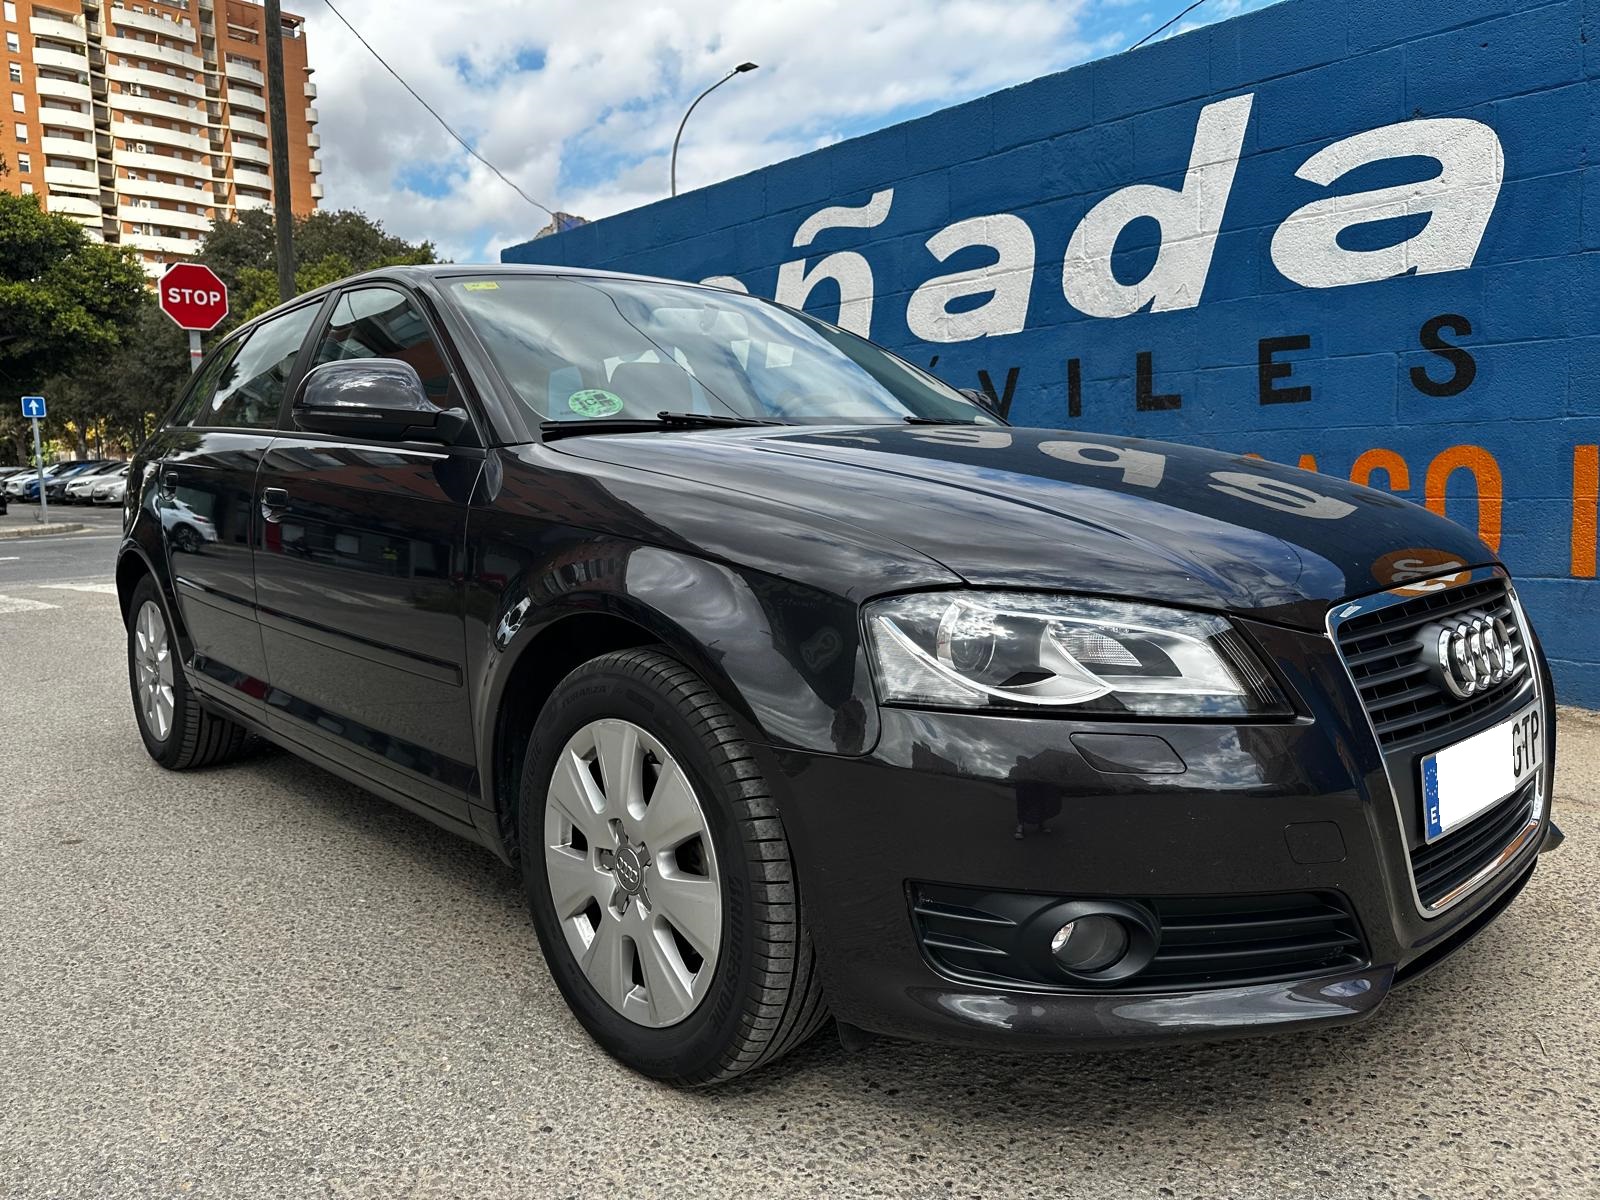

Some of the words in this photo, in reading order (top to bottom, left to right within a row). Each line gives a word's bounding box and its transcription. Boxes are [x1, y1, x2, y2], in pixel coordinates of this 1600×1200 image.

[699, 93, 1504, 341] ñada
[168, 287, 221, 306] STOP
[929, 314, 1477, 420] VILES
[1430, 806, 1438, 825] E
[1512, 710, 1539, 778] GTP
